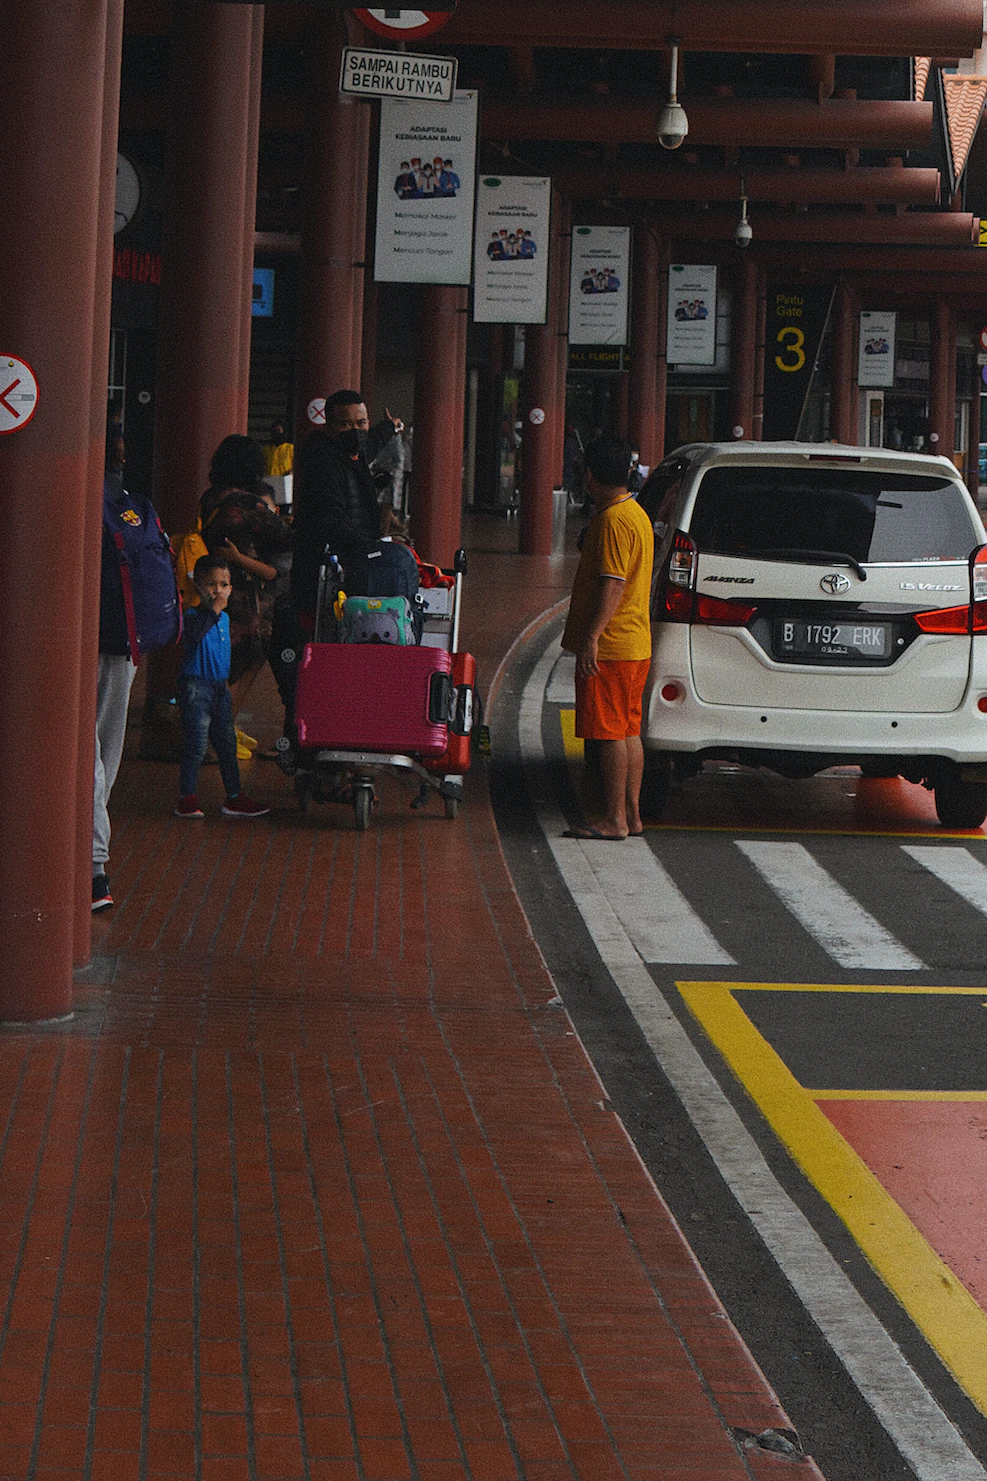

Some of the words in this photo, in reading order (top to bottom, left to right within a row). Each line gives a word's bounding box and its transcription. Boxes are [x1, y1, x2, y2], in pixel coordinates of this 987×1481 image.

[350, 56, 398, 74] SAMPAI
[402, 61, 449, 79] RAMBU
[352, 73, 443, 94] BERIKUTNYA
[775, 326, 806, 372] 3
[703, 576, 755, 585] AVANZA
[784, 623, 793, 641] B
[806, 625, 841, 645] 1792
[853, 627, 882, 646] ERK
